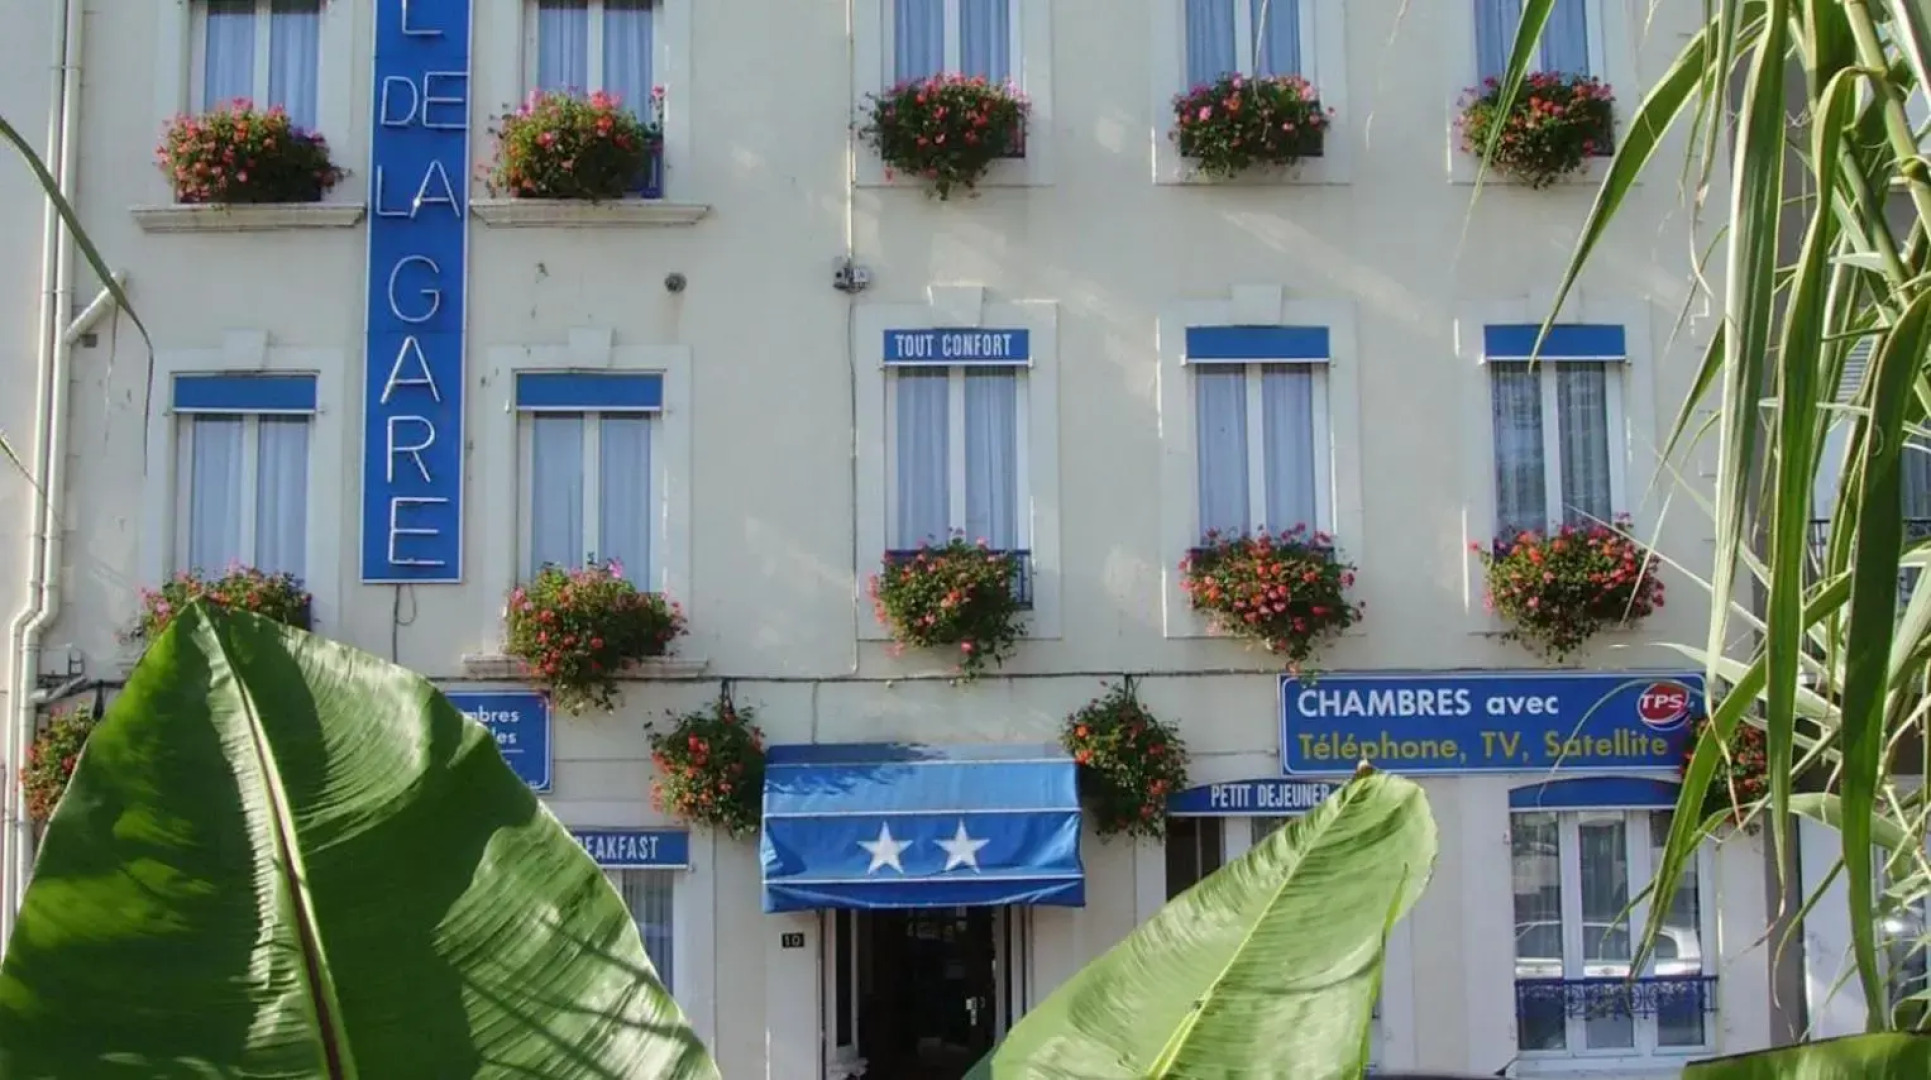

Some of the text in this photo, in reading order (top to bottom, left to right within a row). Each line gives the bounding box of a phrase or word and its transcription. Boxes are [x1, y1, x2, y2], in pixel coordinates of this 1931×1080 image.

[380, 71, 469, 128] DE
[376, 159, 461, 218] LA
[895, 333, 1011, 357] TOUT CONFORT
[380, 254, 449, 566] GARE
[1297, 689, 1559, 717] CHAMBRES avec
[1640, 693, 1683, 710] TPS
[1298, 728, 1668, 763] Téléphone, TV, Satellite
[1210, 783, 1330, 808] PETIT DEJEUNER
[784, 935, 801, 947] 10
